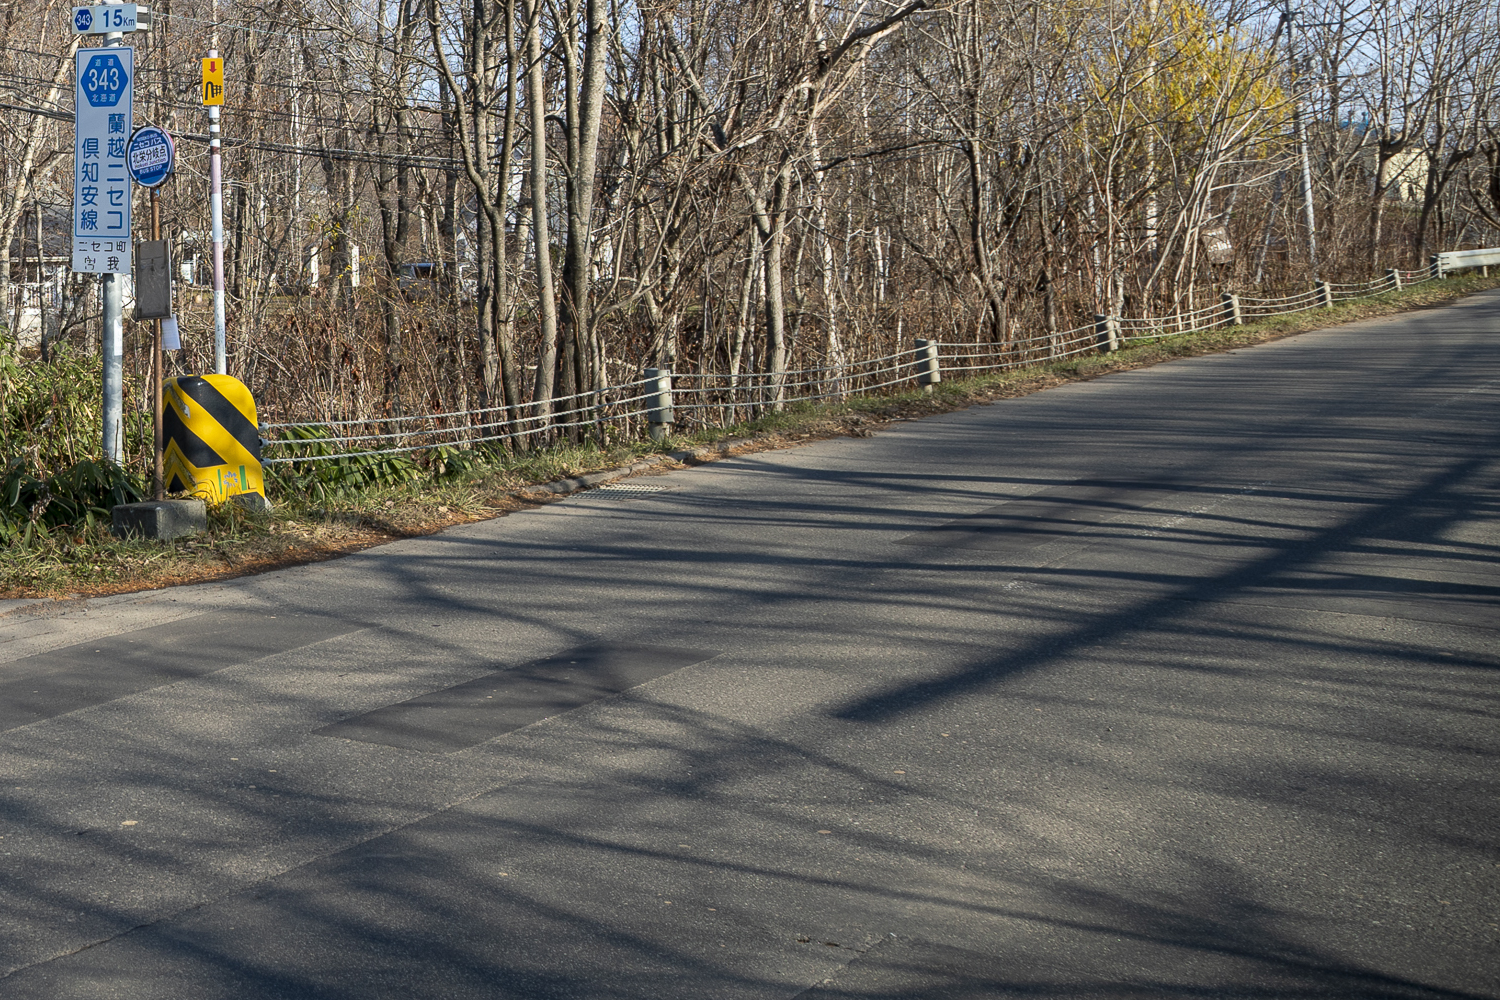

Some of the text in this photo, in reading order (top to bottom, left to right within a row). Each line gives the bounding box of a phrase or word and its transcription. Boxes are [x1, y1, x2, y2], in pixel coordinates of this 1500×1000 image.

[76, 14, 91, 26] 343
[88, 67, 120, 92] 343
[91, 93, 116, 103] 北海道
[132, 144, 167, 164] 北栄分岐点
[106, 113, 126, 230] 蘭越ニセコ
[139, 164, 163, 175] BUS STOP
[80, 137, 100, 231] 倶知安線
[78, 240, 127, 253] ニセコ町
